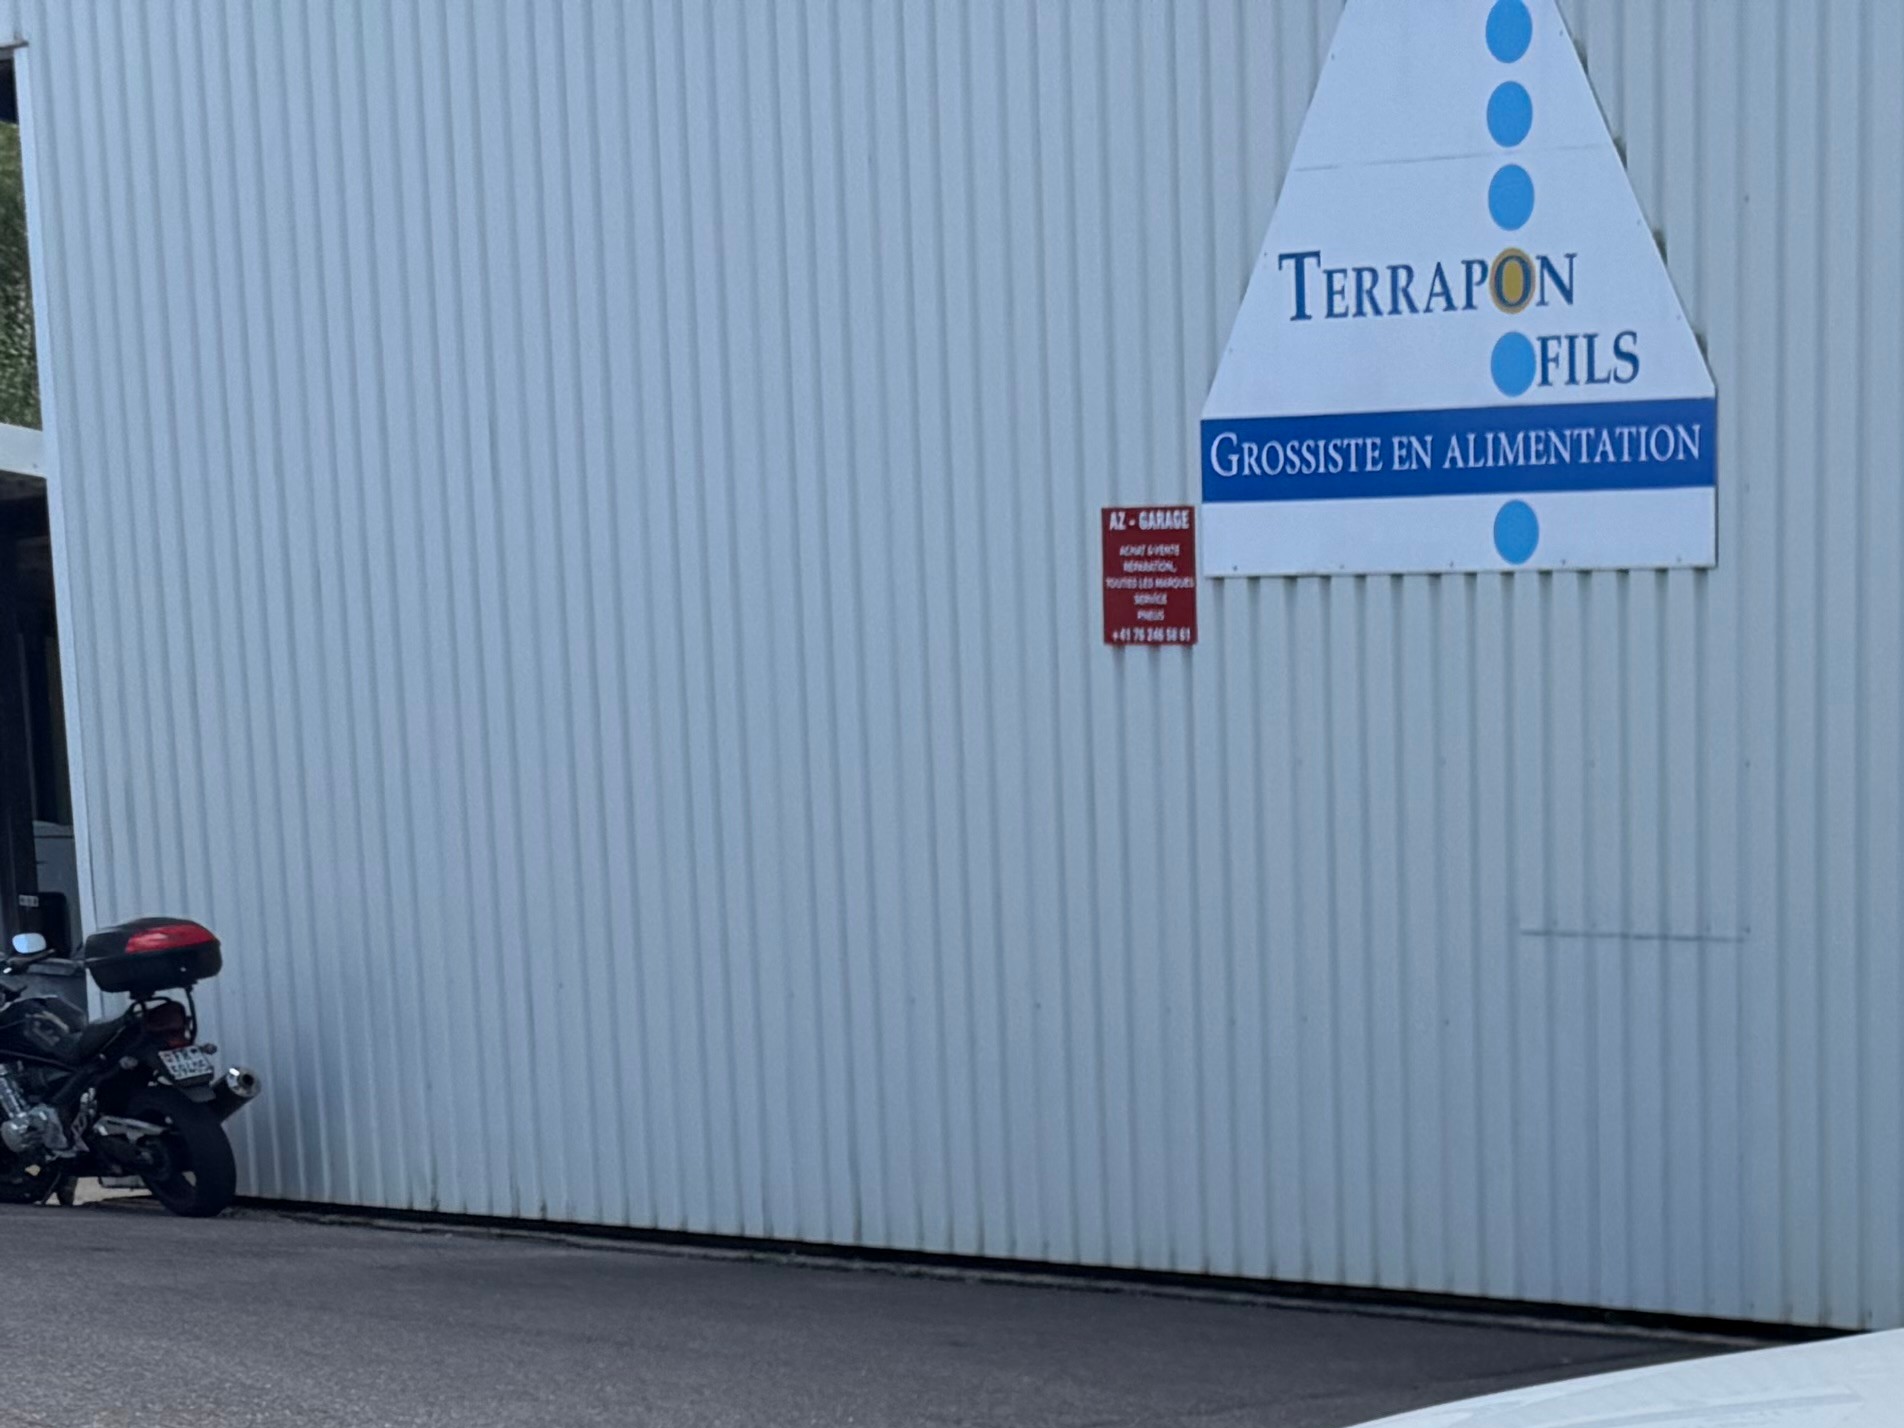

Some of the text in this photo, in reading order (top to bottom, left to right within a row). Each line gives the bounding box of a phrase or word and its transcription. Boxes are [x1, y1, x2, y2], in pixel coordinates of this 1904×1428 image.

[1278, 251, 1577, 321] TERRAPON
[1536, 331, 1640, 387] FILS
[1210, 424, 1701, 477] GROSSISTE EN ALIMENTATION
[1109, 511, 1127, 530] AZ
[1138, 509, 1190, 530] GARAGE
[1138, 575, 1153, 589] LES
[1155, 575, 1195, 589] MARQUES
